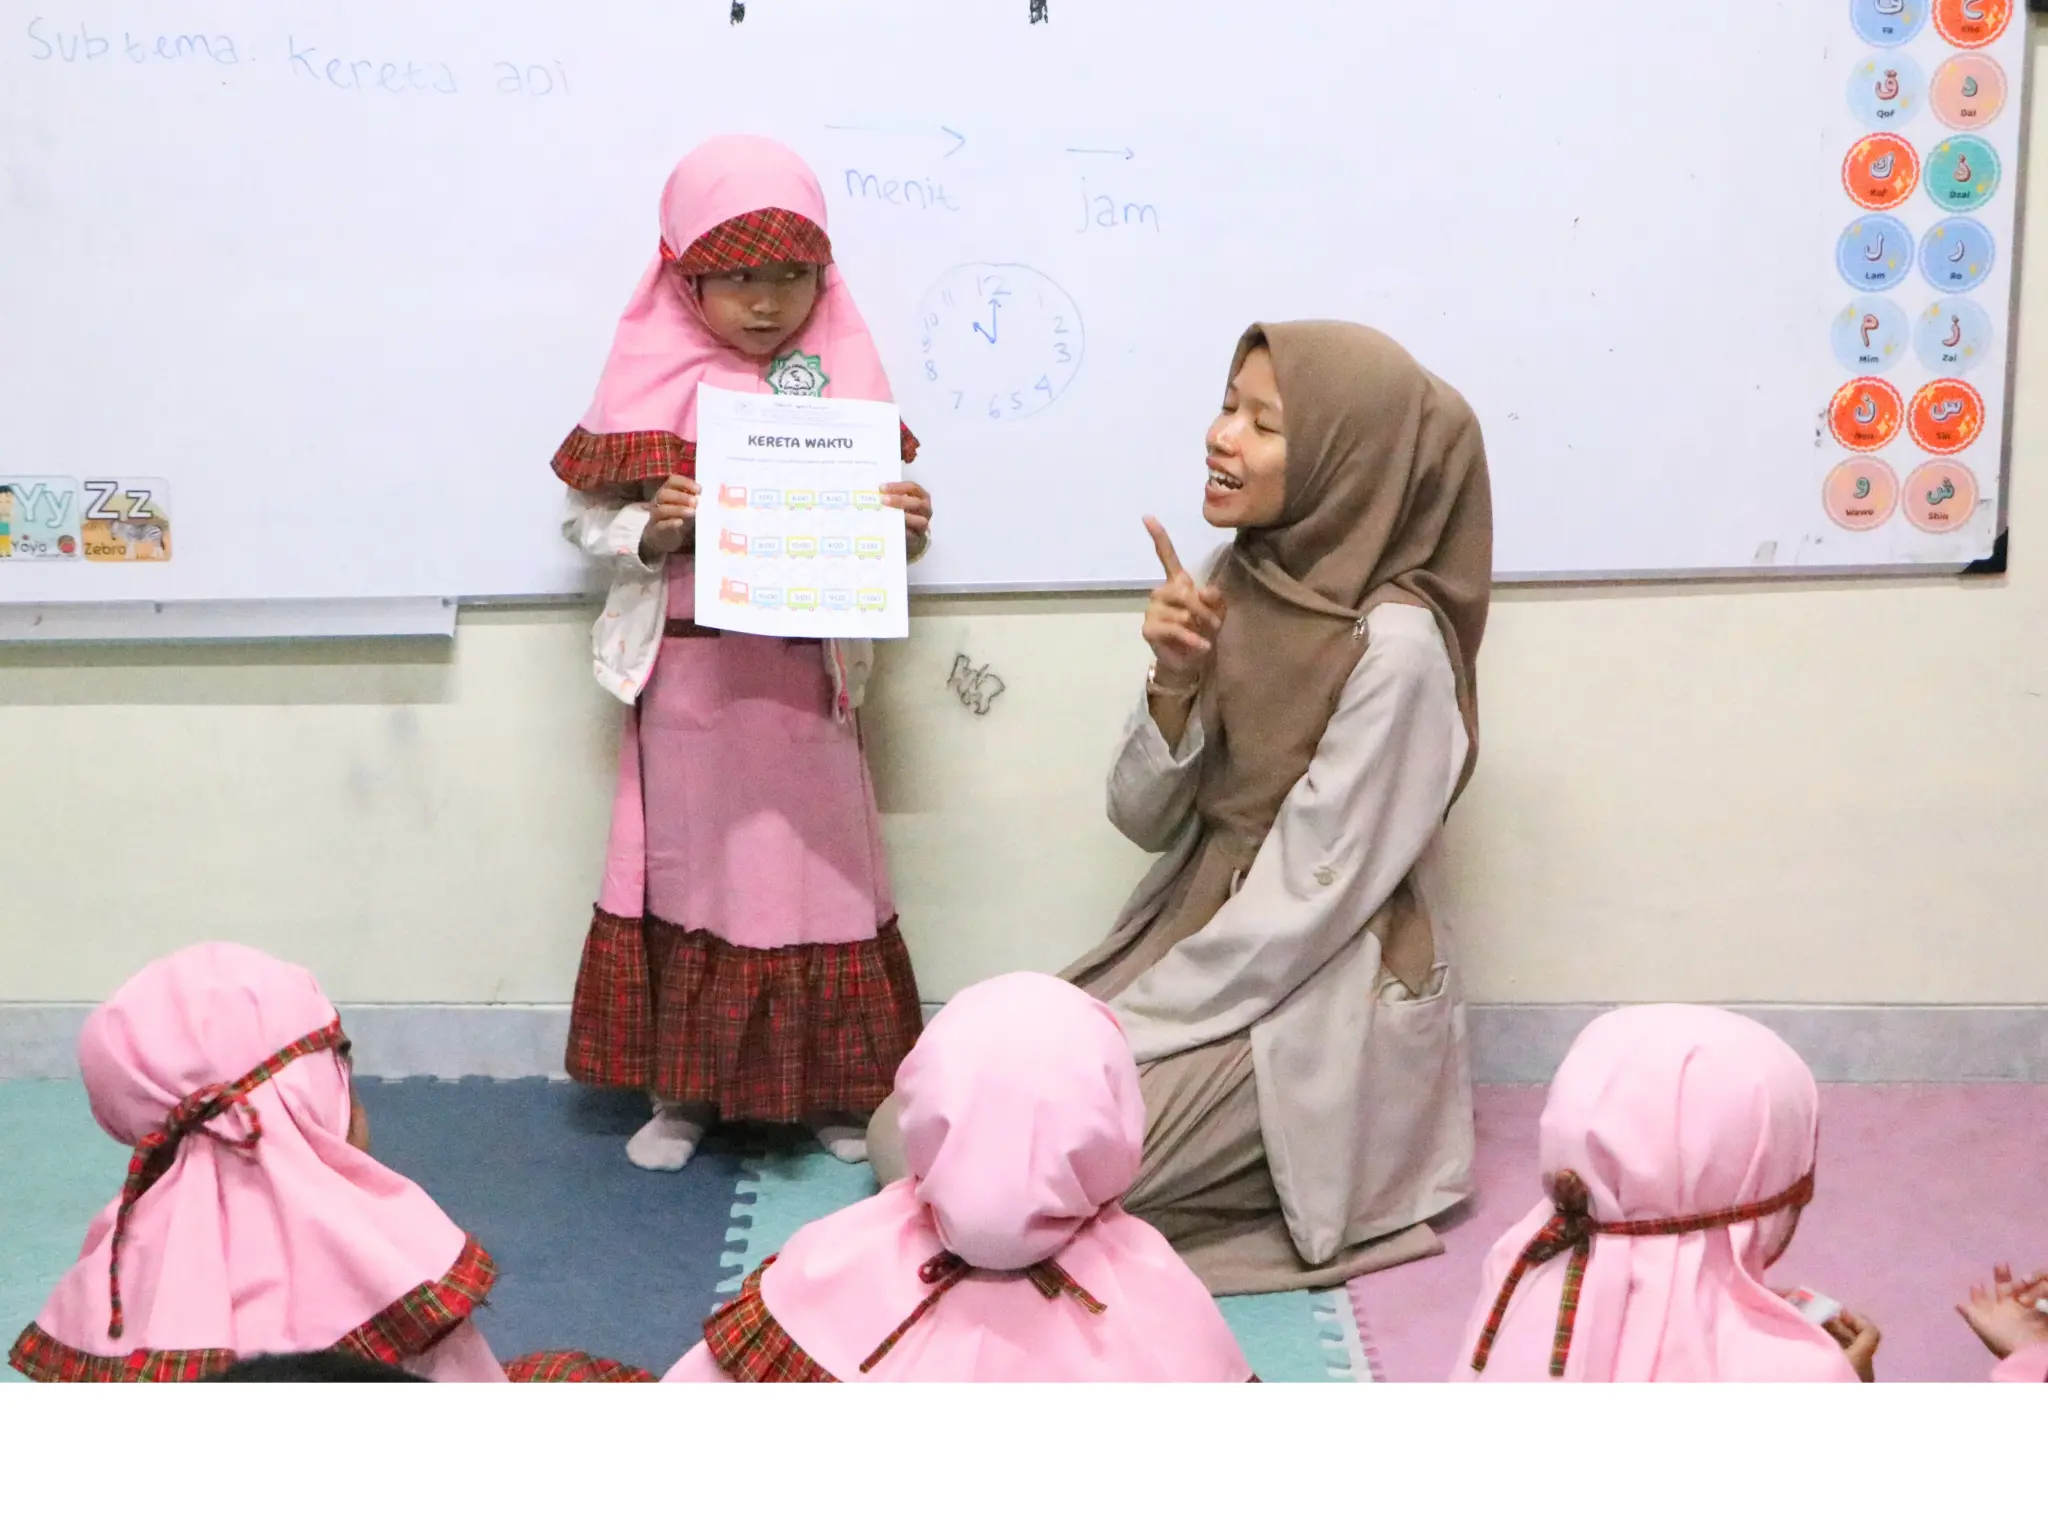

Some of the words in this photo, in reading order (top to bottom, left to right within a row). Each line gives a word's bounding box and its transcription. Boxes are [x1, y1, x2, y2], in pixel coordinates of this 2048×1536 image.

[1075, 175, 1160, 233] jam
[976, 274, 1013, 297] 12
[922, 312, 939, 331] 10
[1052, 315, 1070, 334] 2
[1053, 342, 1072, 363] 3
[924, 359, 939, 382] 8
[1033, 373, 1053, 399] 4
[950, 390, 965, 410] 7
[987, 392, 1001, 419] 6
[1010, 389, 1024, 410] 5
[747, 434, 801, 449] KERETA
[804, 436, 854, 449] WAKTU
[84, 481, 154, 520] Zz
